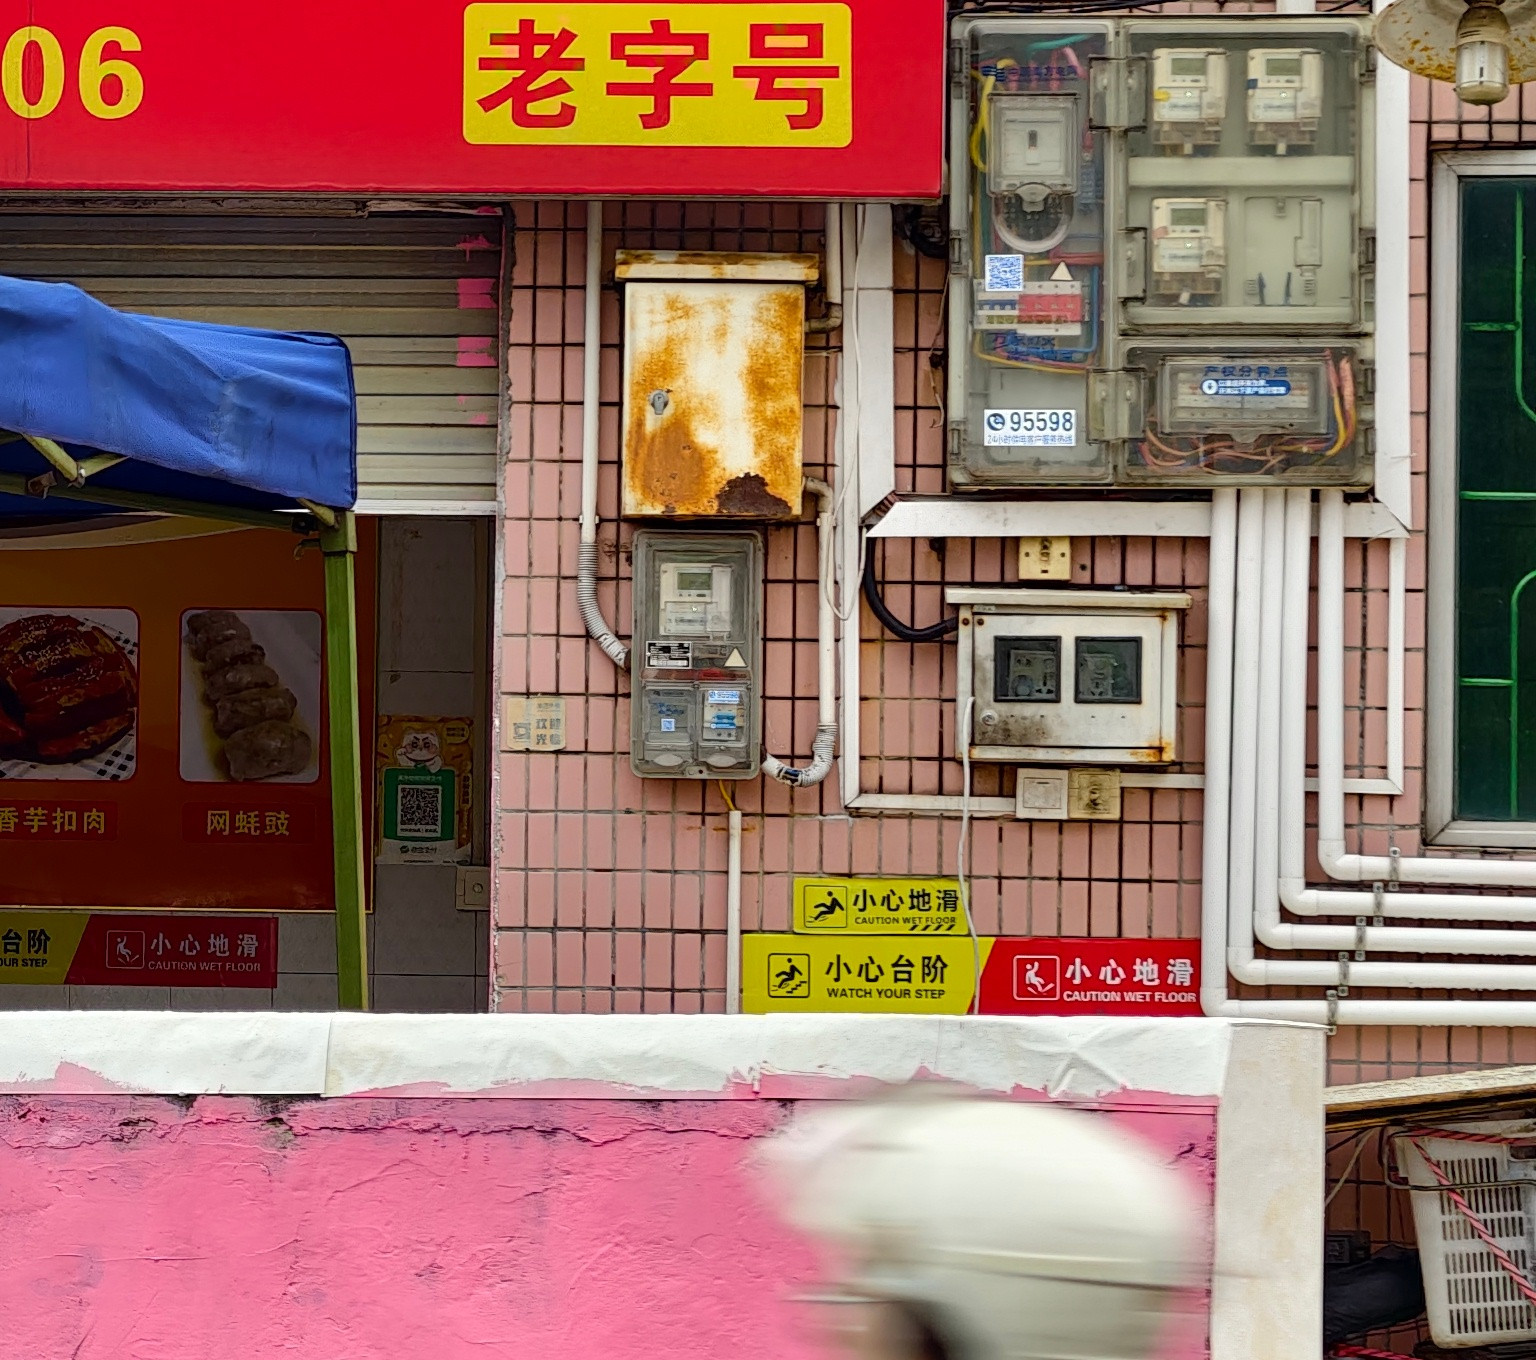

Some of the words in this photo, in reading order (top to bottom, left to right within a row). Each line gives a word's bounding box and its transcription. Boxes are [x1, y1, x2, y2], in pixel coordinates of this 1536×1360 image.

[476, 18, 840, 131] 老字号
[1010, 412, 1073, 432] 95598
[207, 809, 291, 835] 网蚝豉
[852, 888, 959, 913] 小心地滑
[854, 916, 900, 925] CAUTION
[902, 917, 923, 925] WET
[925, 917, 956, 925] FLOOR
[150, 932, 259, 958] 小心地滑
[21, 958, 48, 968] STEP
[148, 961, 197, 971] CAUTION
[199, 962, 223, 971] WET
[225, 962, 261, 972] FLOOR
[825, 954, 948, 984] 小心台阶
[1064, 957, 1194, 986] 小心地滑
[827, 988, 873, 998] WATCH
[875, 988, 911, 999] YOUR
[915, 989, 946, 999] STEP
[1063, 991, 1121, 1002] CAUTION
[1123, 992, 1152, 1002] WET
[1154, 992, 1197, 1003] FLOOR
